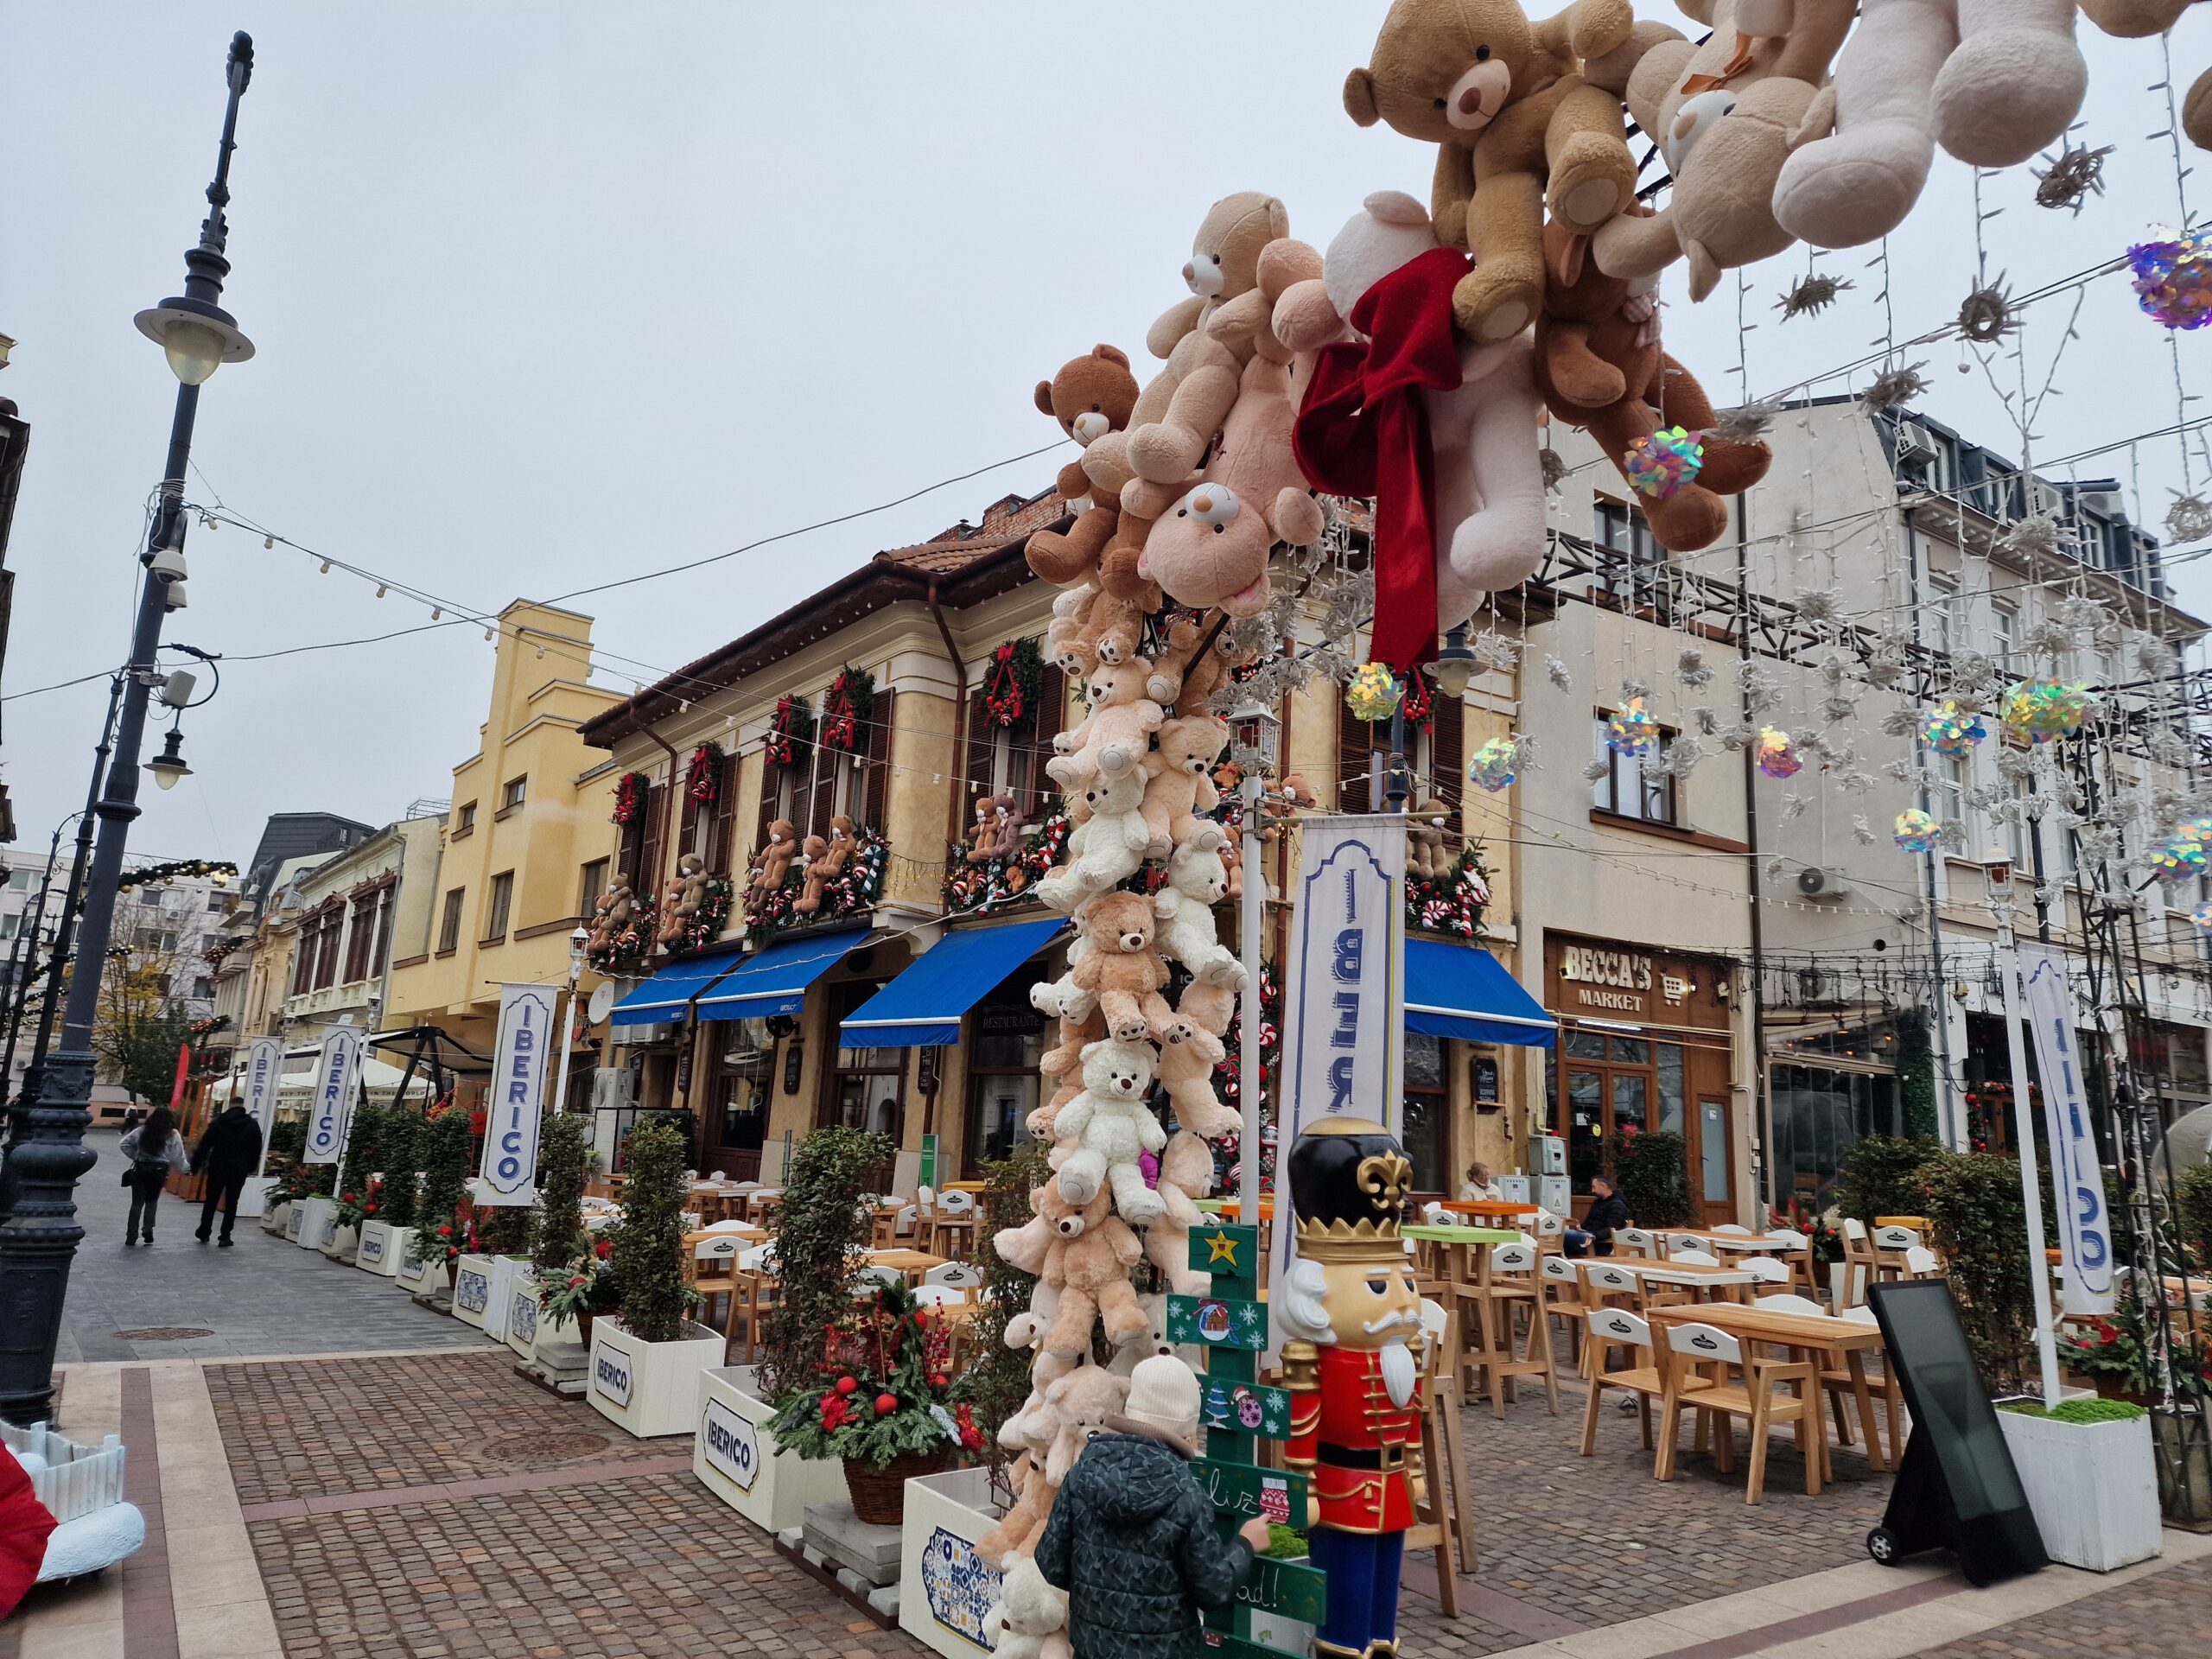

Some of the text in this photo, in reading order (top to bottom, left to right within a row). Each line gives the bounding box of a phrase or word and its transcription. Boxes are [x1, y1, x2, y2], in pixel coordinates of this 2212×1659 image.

[1565, 945, 1652, 991] BECCA'S
[982, 1014, 1041, 1029] RESTAURANTE
[1579, 988, 1643, 1012] MARKET
[249, 1047, 267, 1120] IBERIC
[316, 1038, 345, 1147] IBERICO
[498, 1005, 534, 1180] IBERICO
[597, 1357, 627, 1393] IBERICO
[708, 1419, 751, 1471] IBERICO
